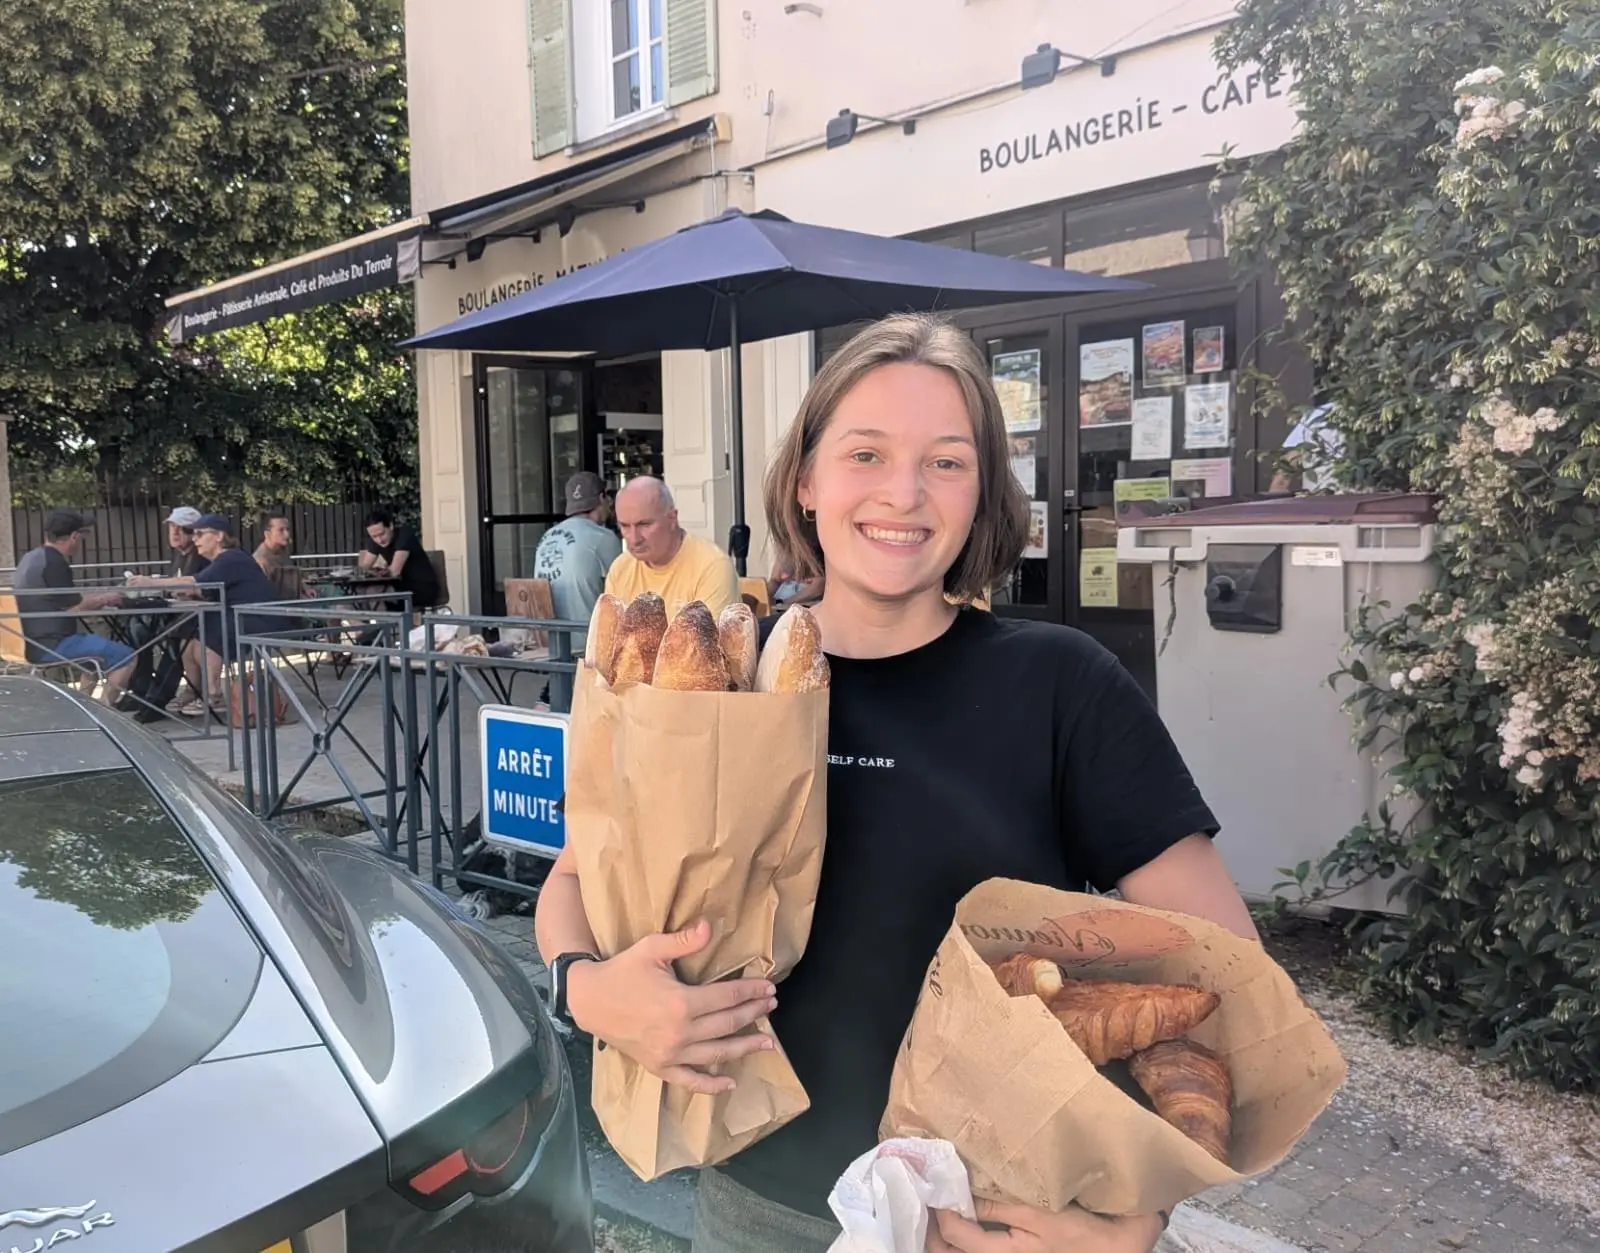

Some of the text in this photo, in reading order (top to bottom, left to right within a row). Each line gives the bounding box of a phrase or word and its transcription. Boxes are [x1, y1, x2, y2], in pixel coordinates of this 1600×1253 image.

[290, 279, 308, 296] Café
[308, 277, 317, 291] et
[318, 268, 350, 289] Produits
[351, 264, 363, 279] Du
[364, 254, 393, 275] Terroir
[497, 747, 553, 779] ARRÊT
[858, 757, 896, 768] CARE
[493, 789, 559, 824] MINUTE
[0, 1212, 116, 1253] UAR
